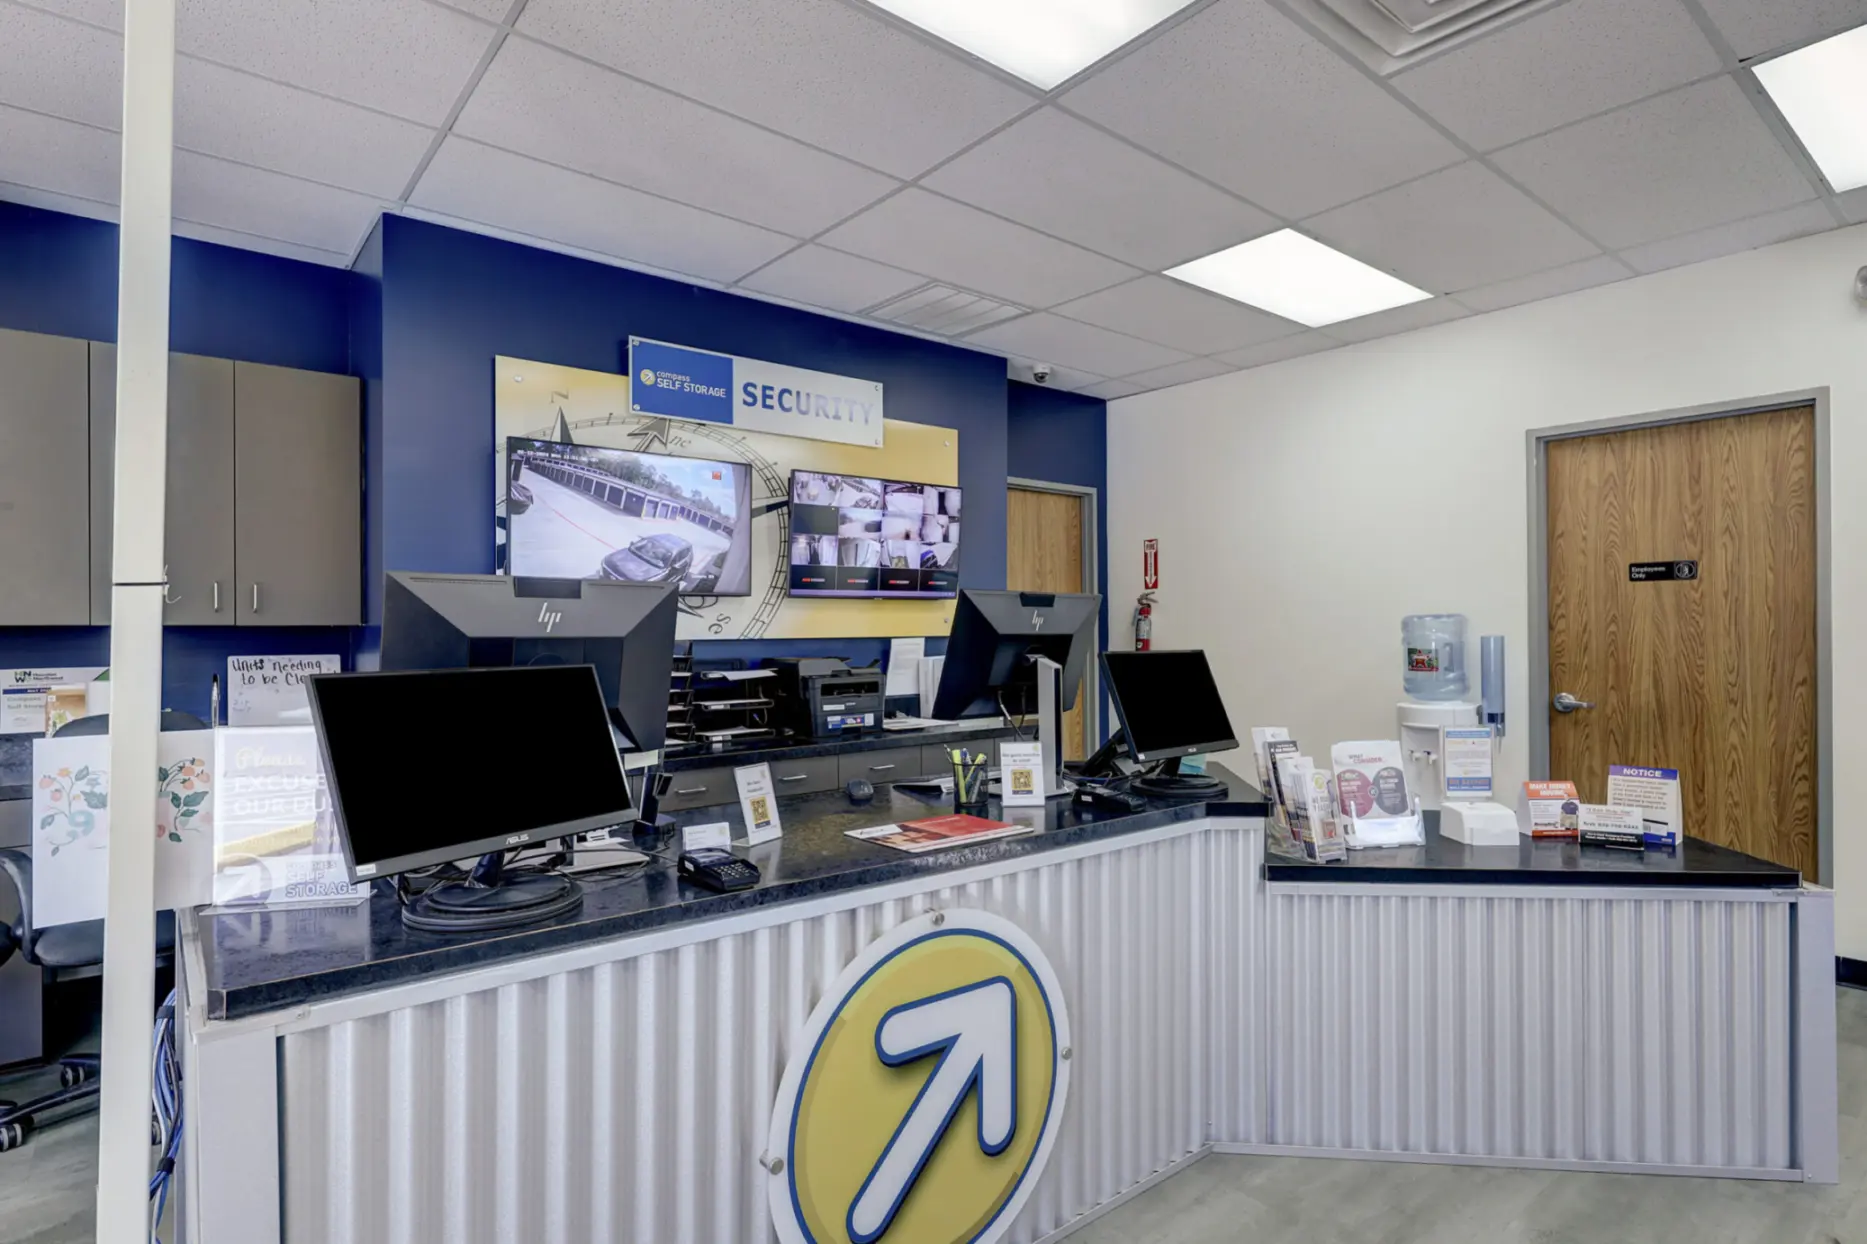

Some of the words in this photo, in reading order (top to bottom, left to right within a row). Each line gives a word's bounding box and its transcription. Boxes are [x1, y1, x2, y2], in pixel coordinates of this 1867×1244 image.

[656, 371, 690, 382] compass
[656, 378, 682, 390] SELF
[683, 382, 727, 398] STORAGE
[742, 381, 874, 425] SECURITY
[538, 602, 562, 633] hp
[1031, 609, 1044, 631] hp
[232, 658, 265, 672] Units
[273, 660, 322, 674] needing
[242, 673, 256, 685] to
[262, 674, 278, 685] be
[1623, 767, 1663, 778] NOTICE
[234, 773, 328, 793] EXCUSE
[234, 798, 285, 815] OUR
[506, 834, 528, 844] ASUS
[285, 881, 358, 898] STORAGE
